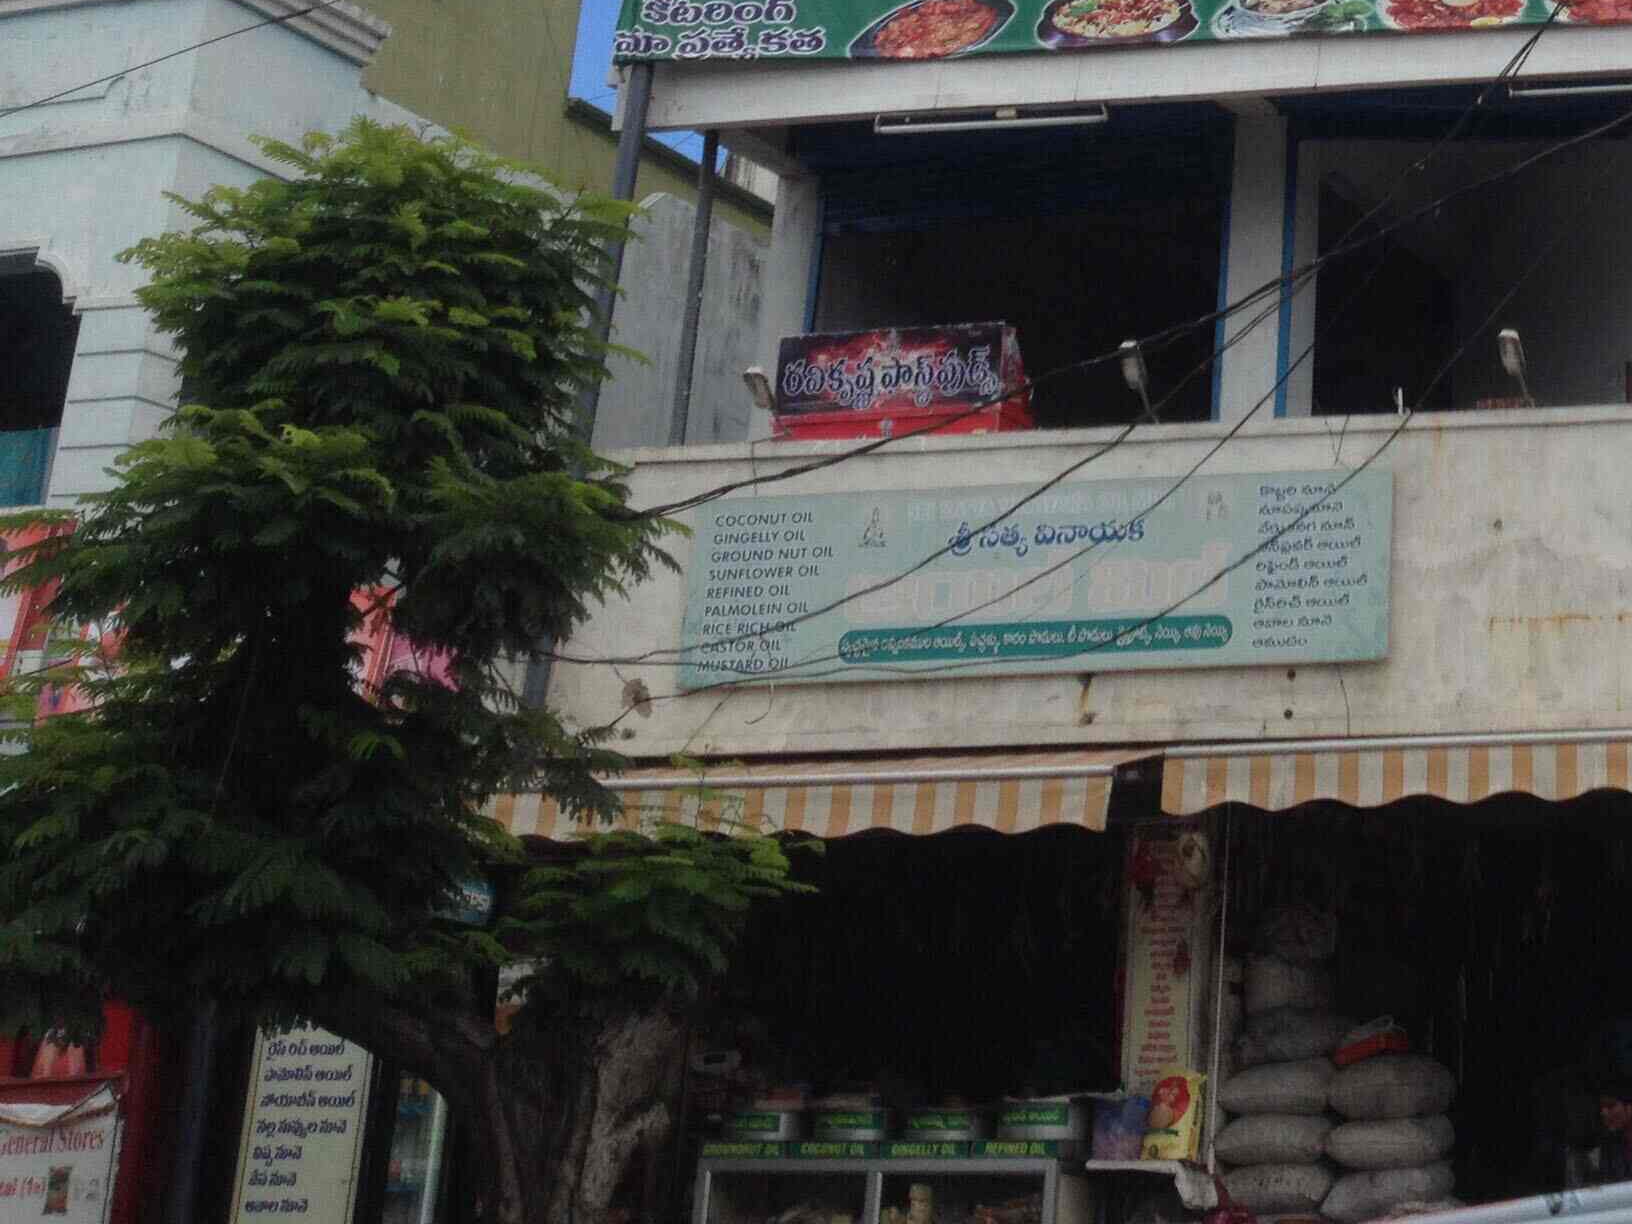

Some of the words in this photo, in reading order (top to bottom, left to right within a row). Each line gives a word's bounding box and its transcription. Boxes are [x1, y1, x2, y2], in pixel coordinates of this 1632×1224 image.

[715, 512, 787, 527] COCONUT
[792, 511, 813, 523] OIL
[713, 531, 779, 545] GINGELLY
[783, 530, 805, 543] OIL
[711, 549, 775, 564] GROUND
[778, 548, 809, 560] NUT
[813, 546, 834, 559] OIL
[708, 566, 793, 582] SUNFLOWER
[798, 565, 820, 577] OIL
[706, 586, 763, 599] REFINED
[768, 584, 790, 597] OIL
[704, 603, 782, 618] PALMOLEIN
[786, 601, 809, 614] OIL
[702, 623, 732, 635] RICE
[775, 620, 797, 633] OIL
[700, 641, 755, 654] CASTOR
[759, 639, 781, 652] OIL
[697, 658, 763, 673] MUSTARD
[768, 657, 791, 670] OIL
